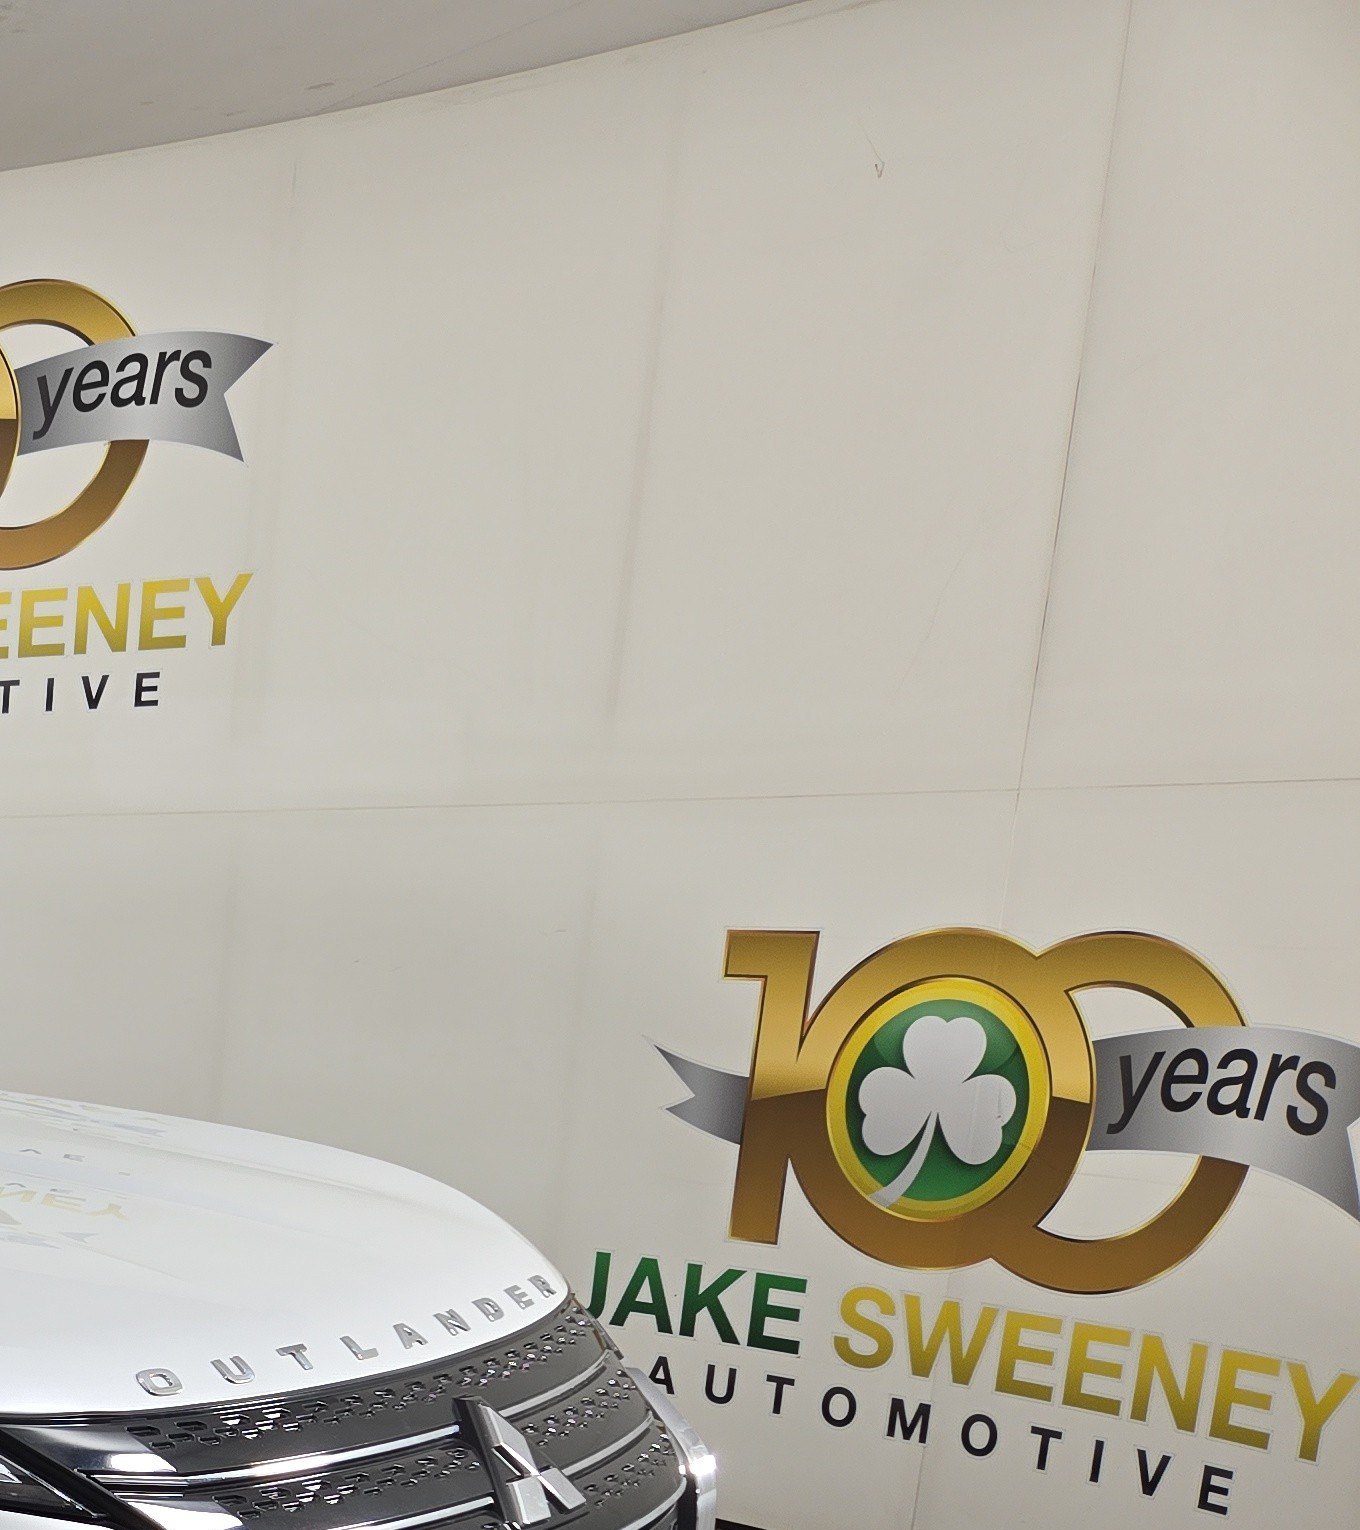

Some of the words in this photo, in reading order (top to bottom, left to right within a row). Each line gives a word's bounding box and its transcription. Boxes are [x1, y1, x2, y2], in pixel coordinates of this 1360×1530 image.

[33, 346, 213, 440] years
[1106, 1046, 1338, 1136] years
[136, 1273, 557, 1398] OUTLANDER
[584, 1250, 808, 1357] JAKE
[833, 1286, 1360, 1463] SWEENEY
[648, 1355, 1235, 1517] AUTOMOTIVE
